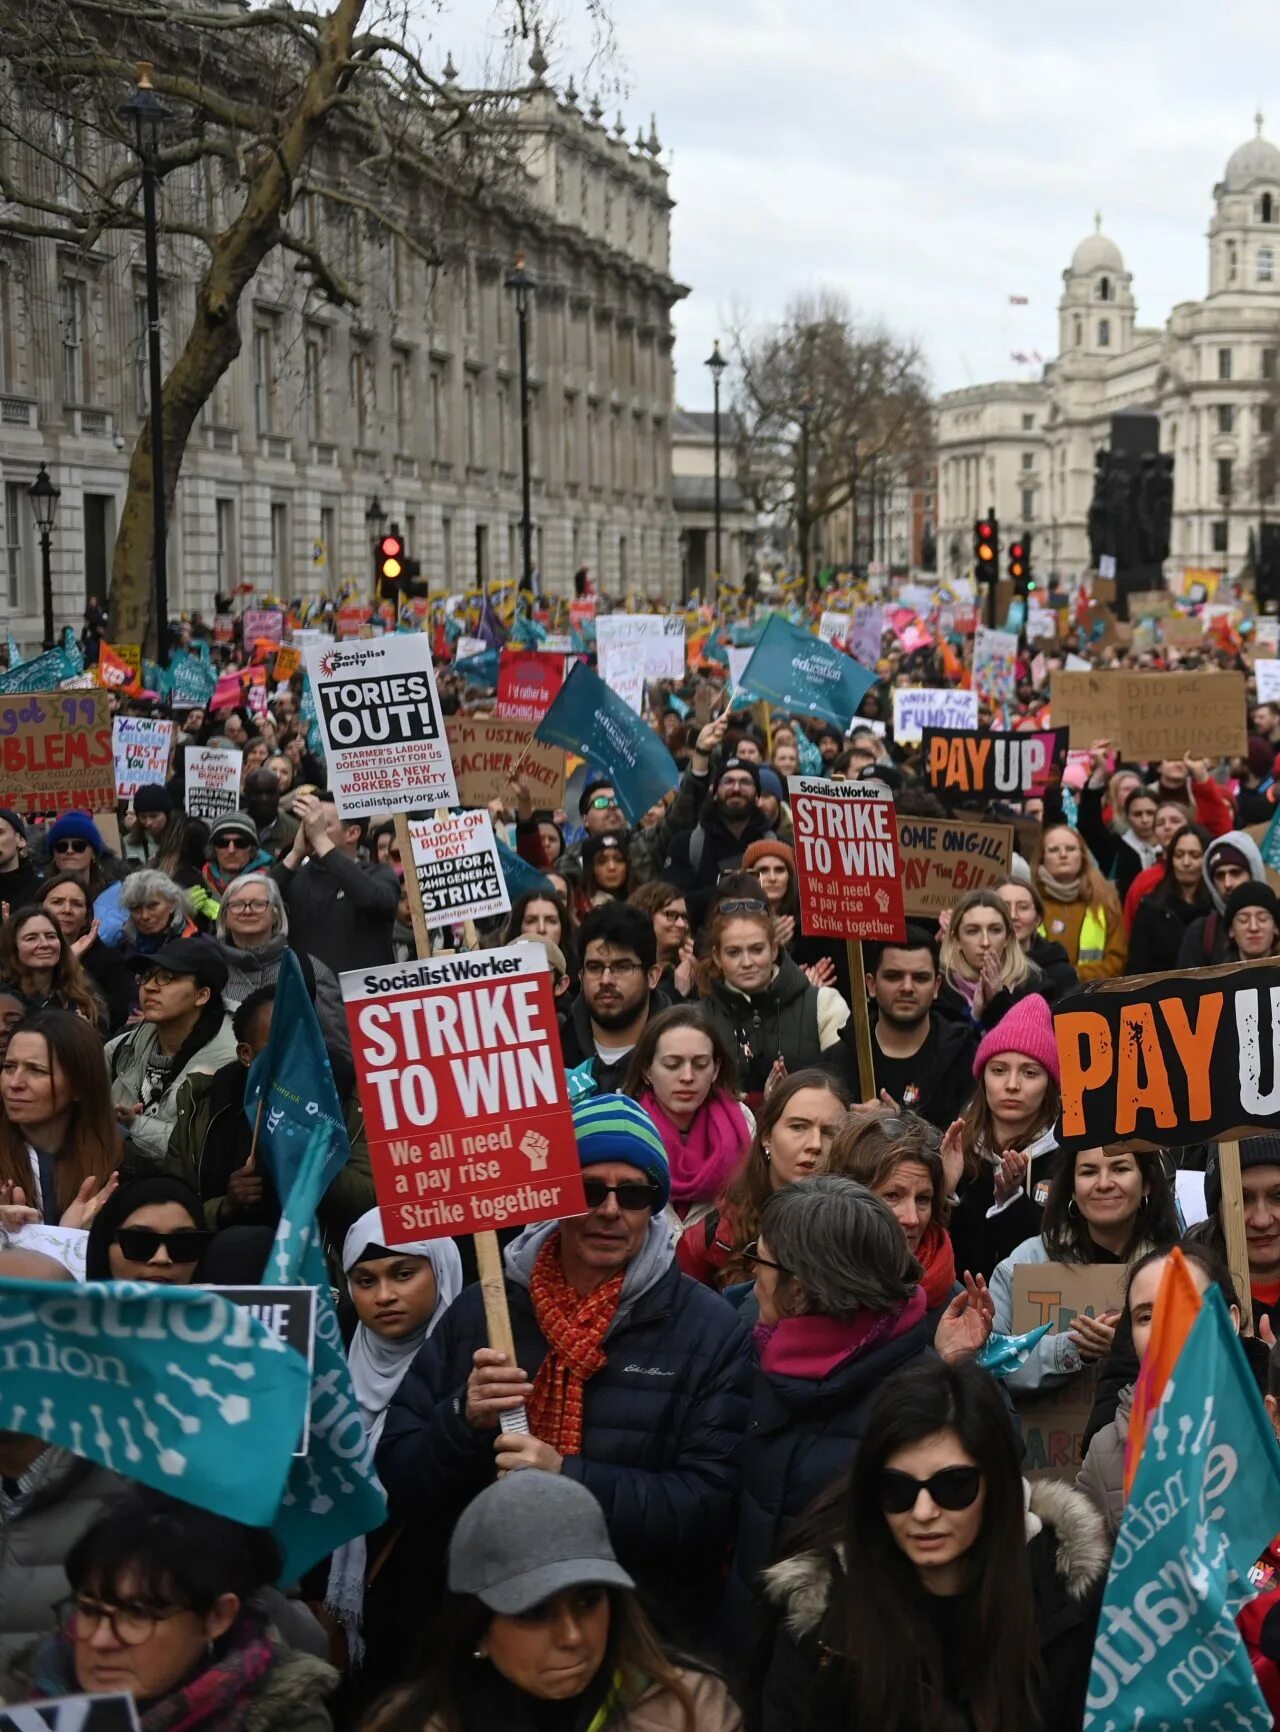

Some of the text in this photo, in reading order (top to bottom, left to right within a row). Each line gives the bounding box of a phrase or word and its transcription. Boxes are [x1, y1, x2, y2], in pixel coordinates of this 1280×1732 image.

[333, 650, 386, 662] Socialist
[792, 657, 841, 681] education
[321, 676, 428, 710] TORIES
[520, 686, 539, 699] rather
[540, 690, 549, 700] be
[0, 696, 95, 735] got 99
[329, 702, 433, 744] OUT!
[498, 703, 532, 720] TEACHING
[485, 728, 533, 744] USING
[0, 730, 113, 772] BLEMS
[126, 744, 161, 758] FIRST
[126, 756, 144, 769] YOU
[336, 750, 442, 770] DOESN'T FIGHT FOR US
[341, 743, 433, 760] STARMER'S LABOUR
[353, 764, 431, 782] BUILD A NEW
[930, 736, 992, 791] PAY
[341, 773, 447, 794] WORKERS' PARTY
[800, 782, 879, 798] Socialist Worker
[342, 789, 451, 810] socialistparty.org.uk
[409, 814, 484, 839] ALL OUT ON
[797, 798, 892, 840] STRIKE
[421, 828, 475, 850] BUDGET
[901, 825, 937, 849] OME
[435, 843, 466, 859] DAY!
[800, 835, 896, 878] TO WIN
[416, 852, 493, 879] BUILD FOR A
[419, 866, 496, 891] 24HR GENERAL
[808, 877, 870, 897] We all need
[422, 879, 500, 910] STRIKE
[810, 895, 863, 913] a pay rise
[812, 914, 895, 935] Strike together
[364, 956, 522, 994] Socialist Worker
[358, 981, 547, 1067] STRIKE
[1053, 991, 1224, 1137] PAY
[366, 1064, 438, 1131] TO
[450, 1045, 558, 1118] WIN
[388, 1123, 513, 1167] We all need
[395, 1158, 501, 1197] a pay rise
[400, 1184, 561, 1230] Strike together
